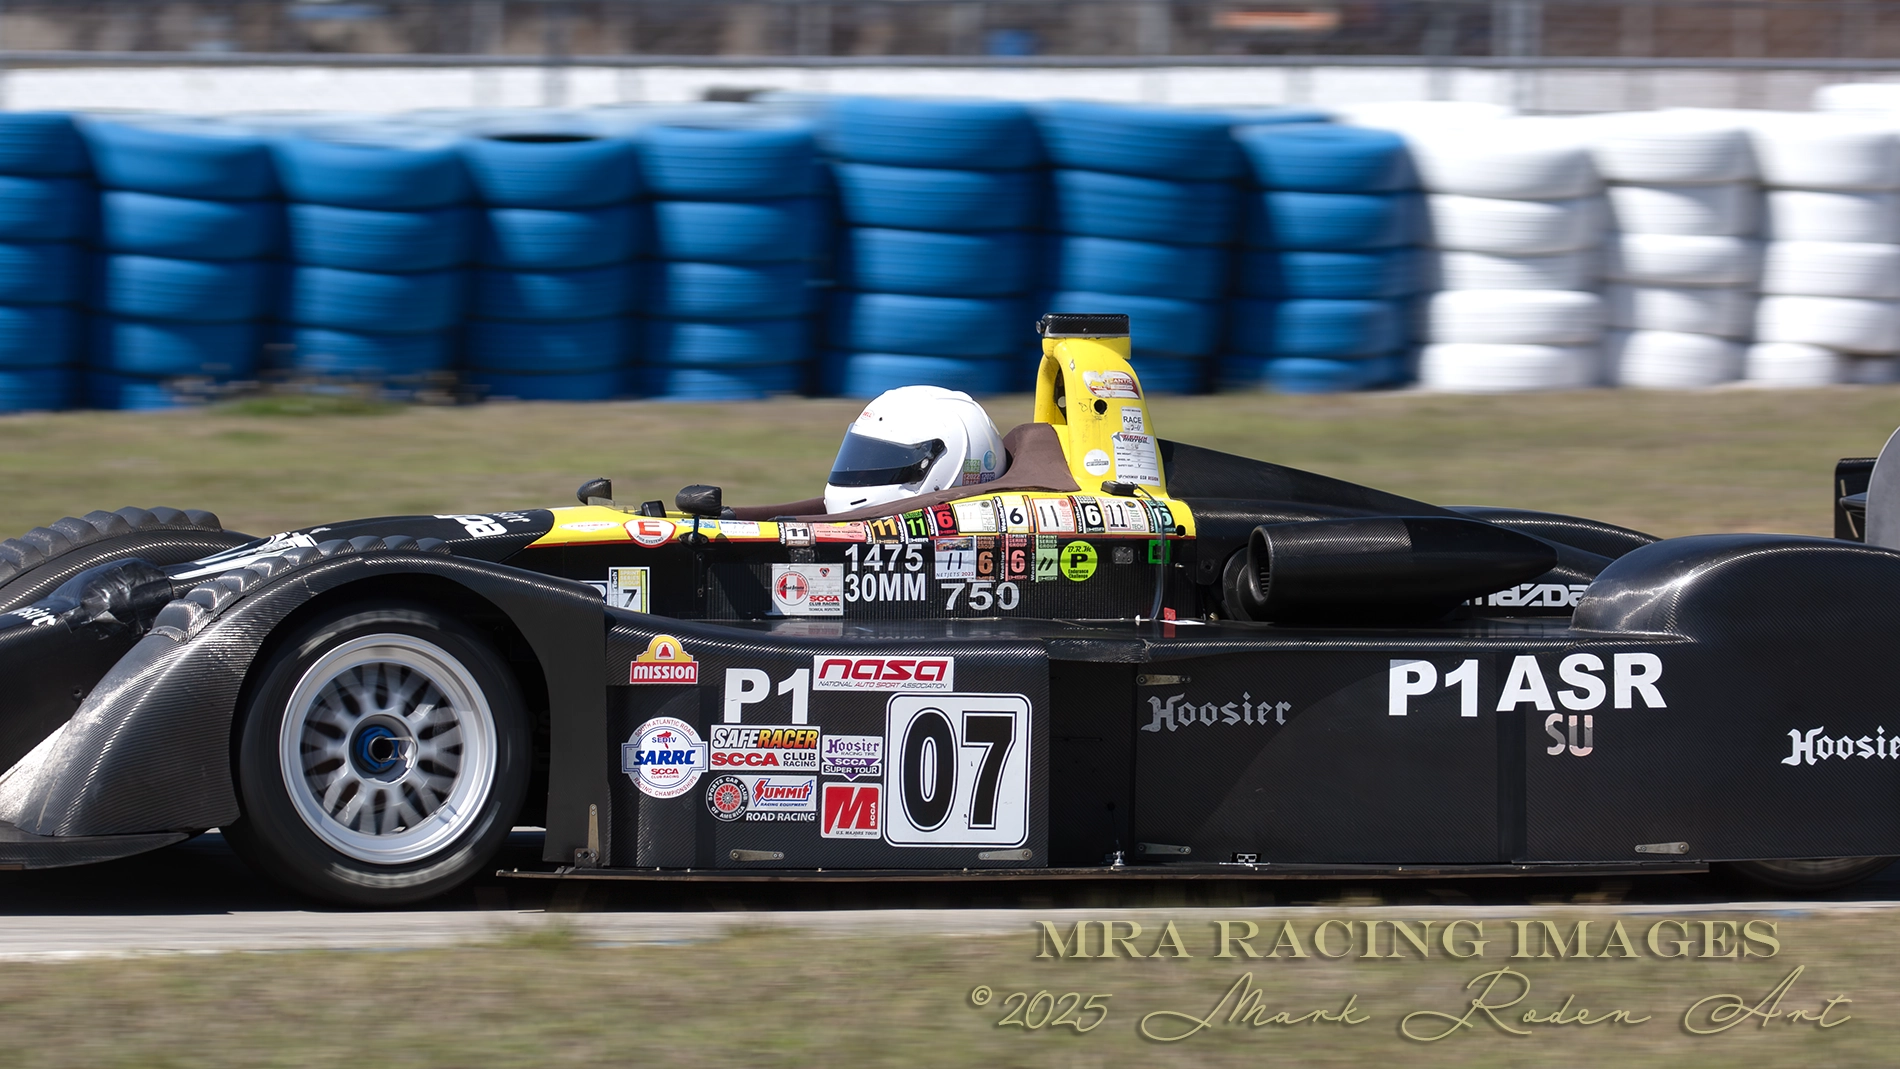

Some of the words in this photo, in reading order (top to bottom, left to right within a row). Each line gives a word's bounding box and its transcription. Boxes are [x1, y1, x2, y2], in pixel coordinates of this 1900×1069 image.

[1123, 416, 1142, 424] RACE
[937, 511, 953, 528] 6
[1010, 508, 1023, 525] 6
[1084, 505, 1101, 525] 6
[1106, 504, 1127, 527] 11
[638, 522, 661, 536] E
[872, 518, 897, 535] 11
[907, 518, 926, 535] 11
[845, 544, 924, 571] 1475
[978, 551, 993, 574] 6
[1011, 550, 1025, 573] 6
[1070, 554, 1088, 568] P
[845, 573, 926, 602] 30MM
[941, 582, 1020, 610] 750
[623, 589, 637, 607] 7
[633, 666, 695, 679] MISSION
[1389, 659, 1478, 717] P1
[1496, 653, 1667, 711] ASR
[724, 668, 810, 724] P1
[1141, 692, 1291, 732] Hoosier
[635, 723, 651, 737] SOUTH
[680, 723, 694, 736] ROAD
[1545, 713, 1594, 756] SU
[825, 738, 879, 754] Hoosier
[1781, 725, 1900, 766] Hoosie
[634, 750, 696, 765] SARRC
[711, 752, 780, 766] SCCA
[900, 707, 1017, 832] 07
[634, 778, 652, 794] RACING
[654, 776, 697, 796] CHAMPIONSHIPS
[708, 778, 724, 801] SPORTS
[739, 784, 748, 802] CLUB
[711, 806, 718, 814] OF
[720, 805, 745, 819] AMERICA
[746, 812, 775, 821] ROAD
[777, 812, 816, 821] RACING
